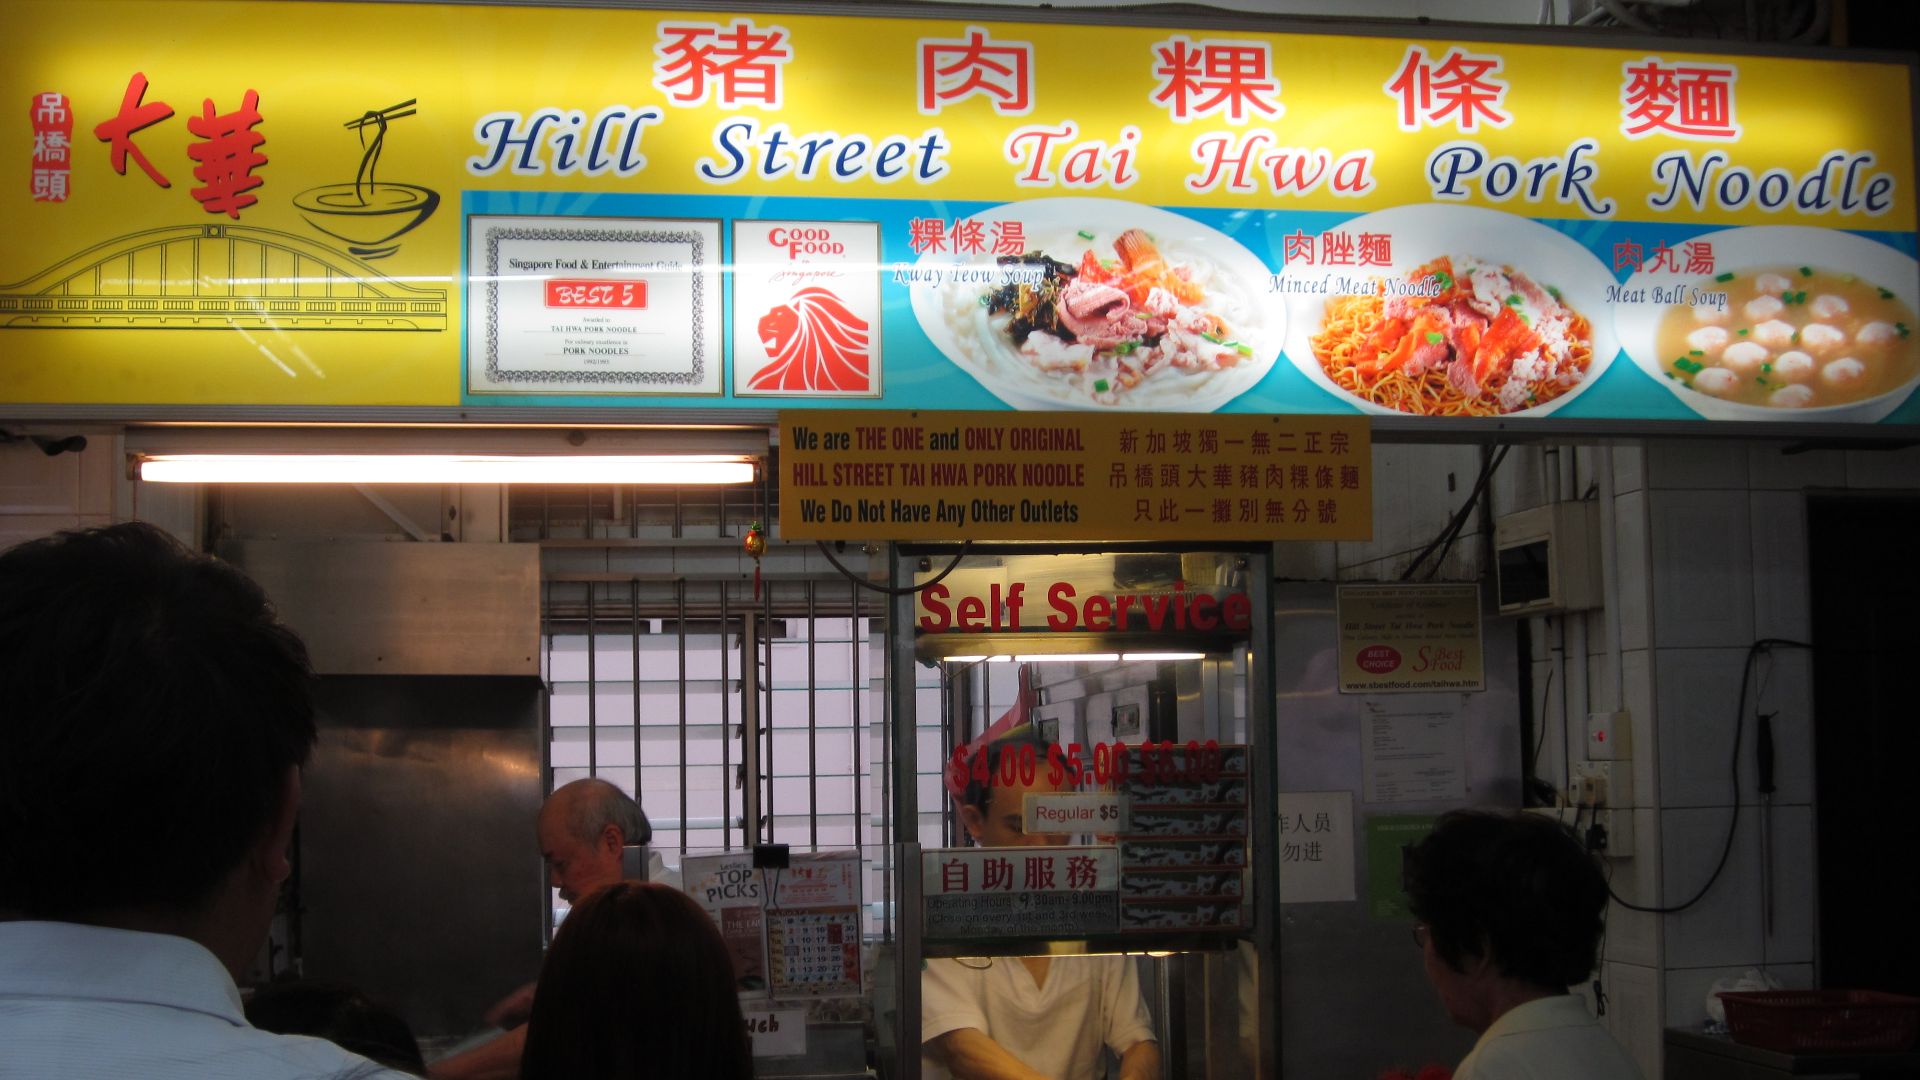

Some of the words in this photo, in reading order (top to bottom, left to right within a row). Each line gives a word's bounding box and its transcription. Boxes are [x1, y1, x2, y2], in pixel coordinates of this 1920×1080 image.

[660, 24, 1737, 137] 豬肉粿條麵
[33, 92, 71, 201] 吊橋頭
[93, 71, 268, 220] 大華
[472, 111, 657, 171] Hill
[701, 123, 944, 179] Street
[1009, 126, 1134, 184] Tai
[1189, 135, 1369, 192] Hwa
[1430, 143, 1611, 214] Pork
[1651, 155, 1892, 211] Noodle
[768, 228, 830, 247] GOOD
[909, 217, 1026, 256] 粿條湯
[789, 241, 845, 260] FOOD
[1613, 238, 1715, 275] 肉丸湯
[509, 258, 553, 271] Singapore
[555, 259, 577, 270] Food
[580, 259, 589, 270] &
[591, 260, 653, 271] Entertainment
[893, 262, 943, 289] Kway
[951, 264, 996, 284] Teow
[1000, 265, 1045, 291] Soup
[555, 286, 615, 306] BEST
[621, 284, 636, 306] 5
[1268, 274, 1331, 294] Minced
[1334, 277, 1377, 295] Meat
[1383, 277, 1442, 297] Noodle
[1606, 285, 1646, 303] Meat
[1651, 285, 1687, 304] Ball
[1689, 287, 1727, 312] Soup
[551, 325, 564, 333] TAI
[565, 325, 582, 333] HWA
[605, 326, 638, 334] NOODLE
[563, 347, 586, 355] PORK
[588, 347, 630, 356] NOODLES
[792, 427, 818, 450] We
[823, 432, 850, 450] are
[855, 427, 887, 450] THE
[892, 427, 924, 450] ONE
[929, 427, 960, 451] and
[965, 427, 1005, 451] ONLY
[1010, 427, 1085, 452] ORIGINAL
[1120, 428, 1350, 455] 新加坡獨一無二正宗
[793, 463, 828, 487] HILL
[833, 463, 895, 487] STREET
[900, 463, 925, 487] TAI
[931, 463, 968, 487] HWA
[973, 463, 1017, 487] PORK
[1022, 463, 1085, 488] NOODLE
[800, 499, 826, 523] We
[831, 499, 852, 523] Do
[857, 499, 886, 523] Not
[890, 499, 931, 523] Have
[936, 499, 966, 528] Any
[971, 499, 1015, 523] Other
[1020, 498, 1079, 523] Outlets
[1134, 498, 1338, 524] 只此一攤別無分號
[920, 581, 1025, 633] Self
[1046, 581, 1252, 633] Service
[1362, 660, 1396, 669] CHOICE
[1367, 650, 1390, 658] BEST
[952, 743, 1036, 791] $4.00
[1046, 741, 1130, 790] $5.00
[1035, 806, 1095, 823] Regular
[1099, 805, 1119, 822] $5
[1283, 841, 1323, 863] 勿进
[714, 869, 752, 885] TOP
[942, 855, 1099, 893] 自助服務
[706, 884, 759, 903] PICKS
